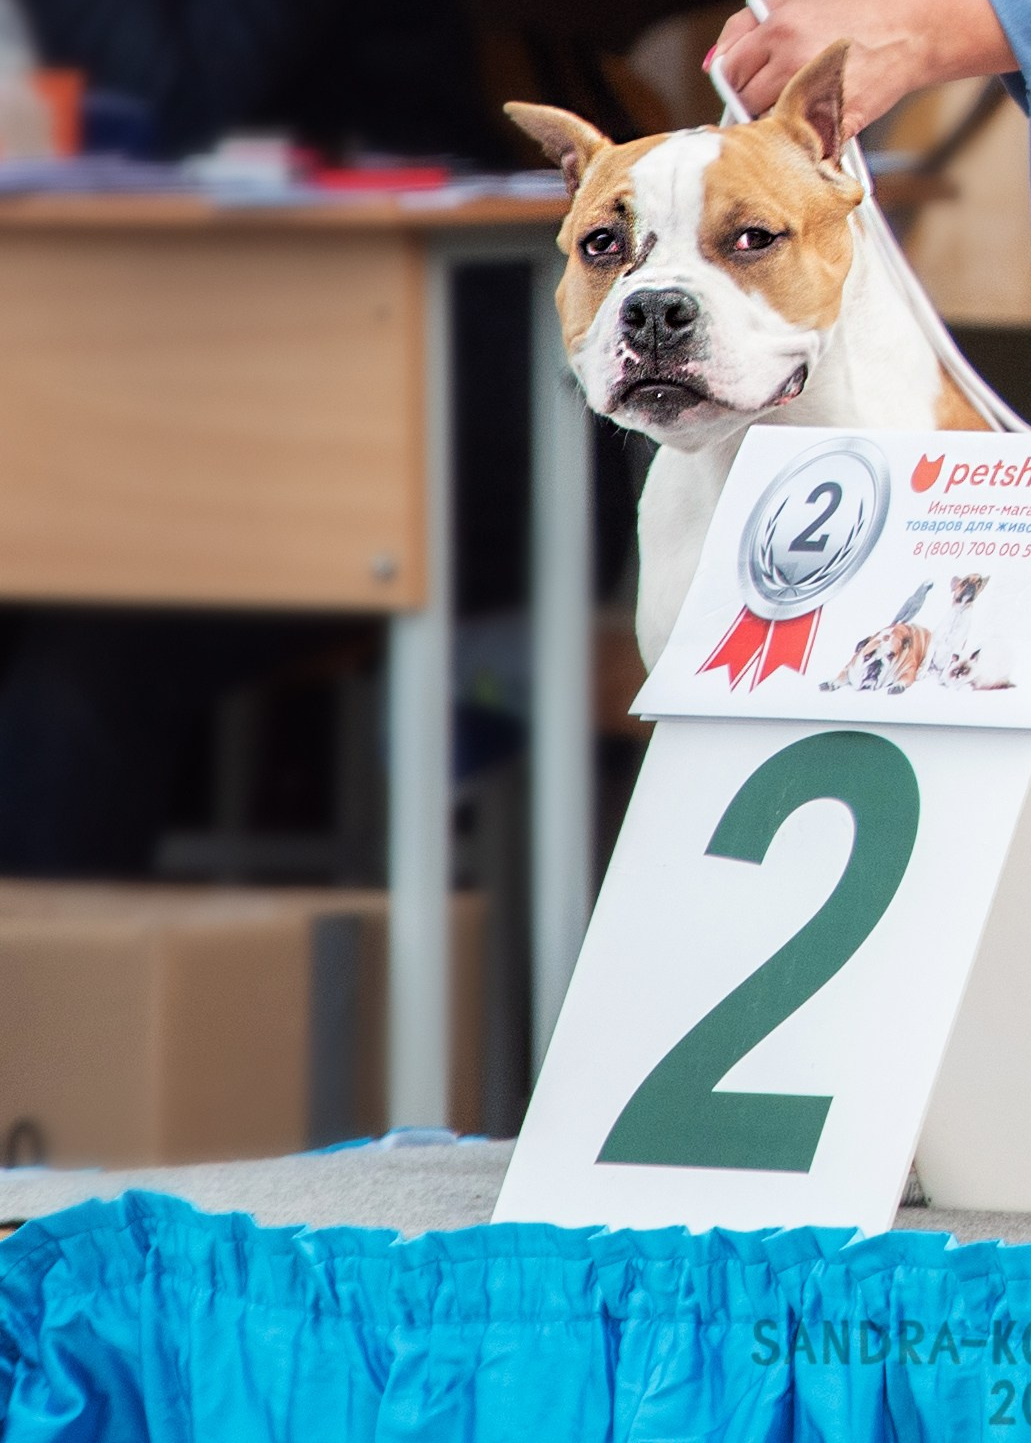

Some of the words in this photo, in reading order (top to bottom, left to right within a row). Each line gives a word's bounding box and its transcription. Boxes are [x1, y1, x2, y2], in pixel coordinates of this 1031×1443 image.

[788, 482, 843, 553] 2
[905, 521, 963, 533] товаров
[964, 521, 993, 532] для
[912, 541, 924, 556] 8
[924, 541, 964, 559] (800)
[967, 542, 996, 557] 700
[999, 543, 1021, 557] 00
[594, 730, 921, 1174] 2
